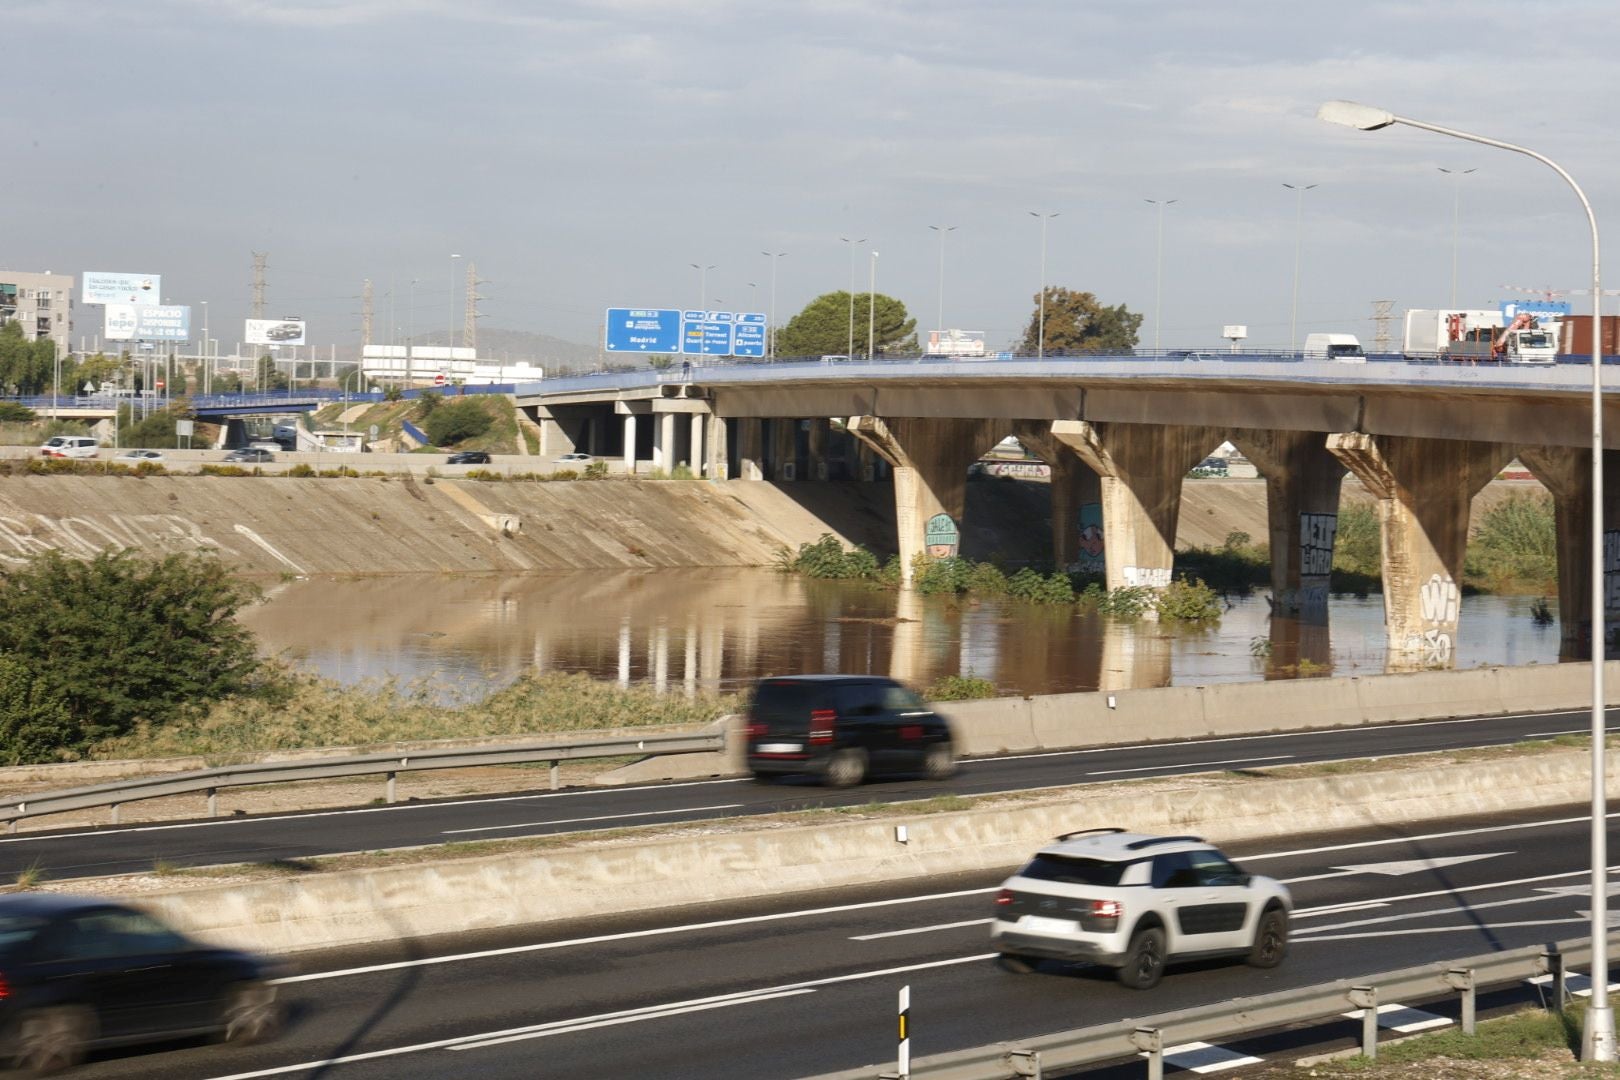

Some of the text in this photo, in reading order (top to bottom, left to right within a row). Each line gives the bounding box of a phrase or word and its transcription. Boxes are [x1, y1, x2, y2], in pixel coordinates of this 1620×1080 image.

[143, 309, 182, 318] ESPACIO
[142, 319, 182, 327] DISPONIBLE
[630, 336, 657, 344] Madrid
